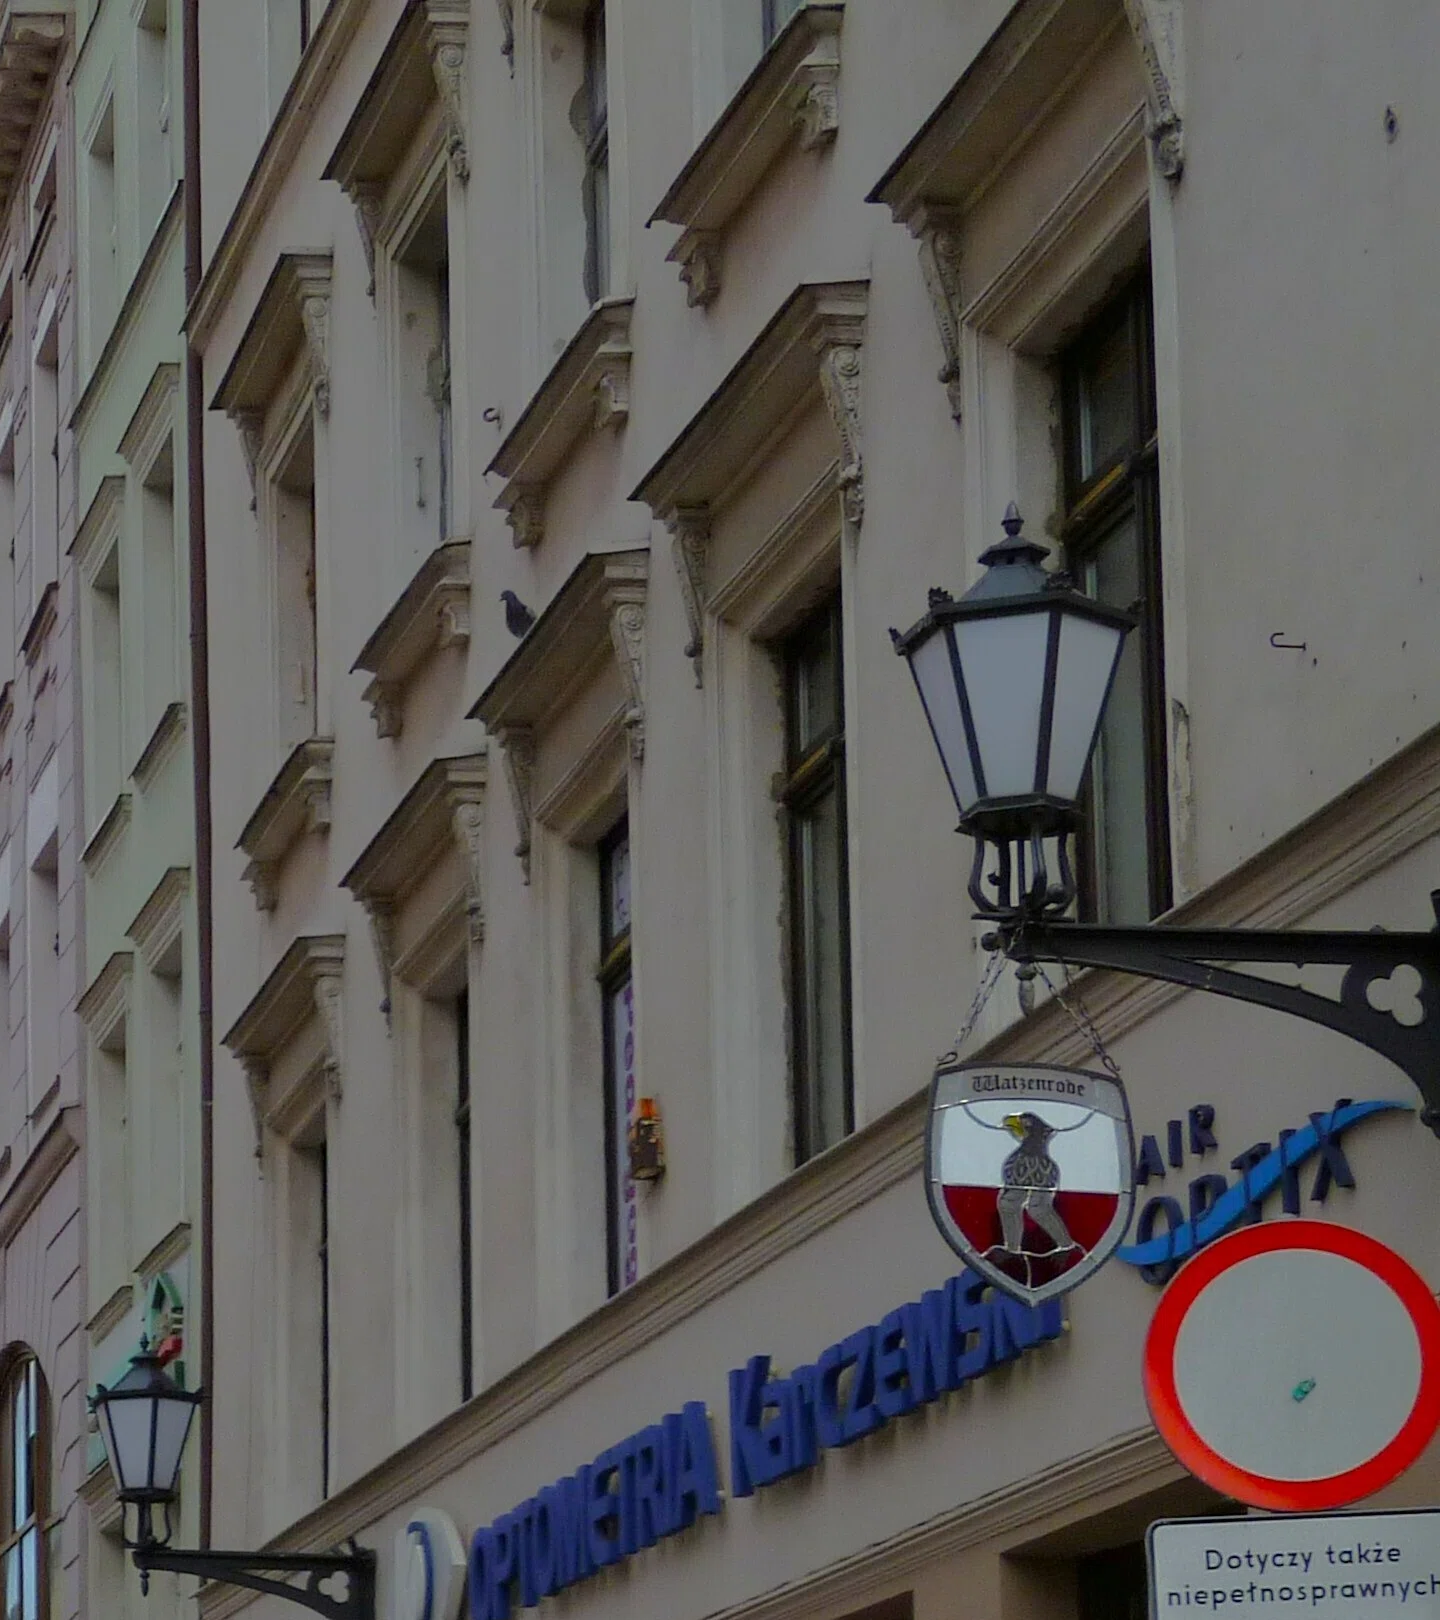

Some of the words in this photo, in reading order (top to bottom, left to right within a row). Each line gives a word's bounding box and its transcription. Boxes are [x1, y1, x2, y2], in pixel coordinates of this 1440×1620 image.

[1135, 1103, 1218, 1185] AIR
[1137, 1098, 1356, 1286] OPTIX
[1205, 1549, 1313, 1575] Dotyczy
[1326, 1542, 1402, 1565] także
[1167, 1574, 1440, 1611] niepełnosprawnych
